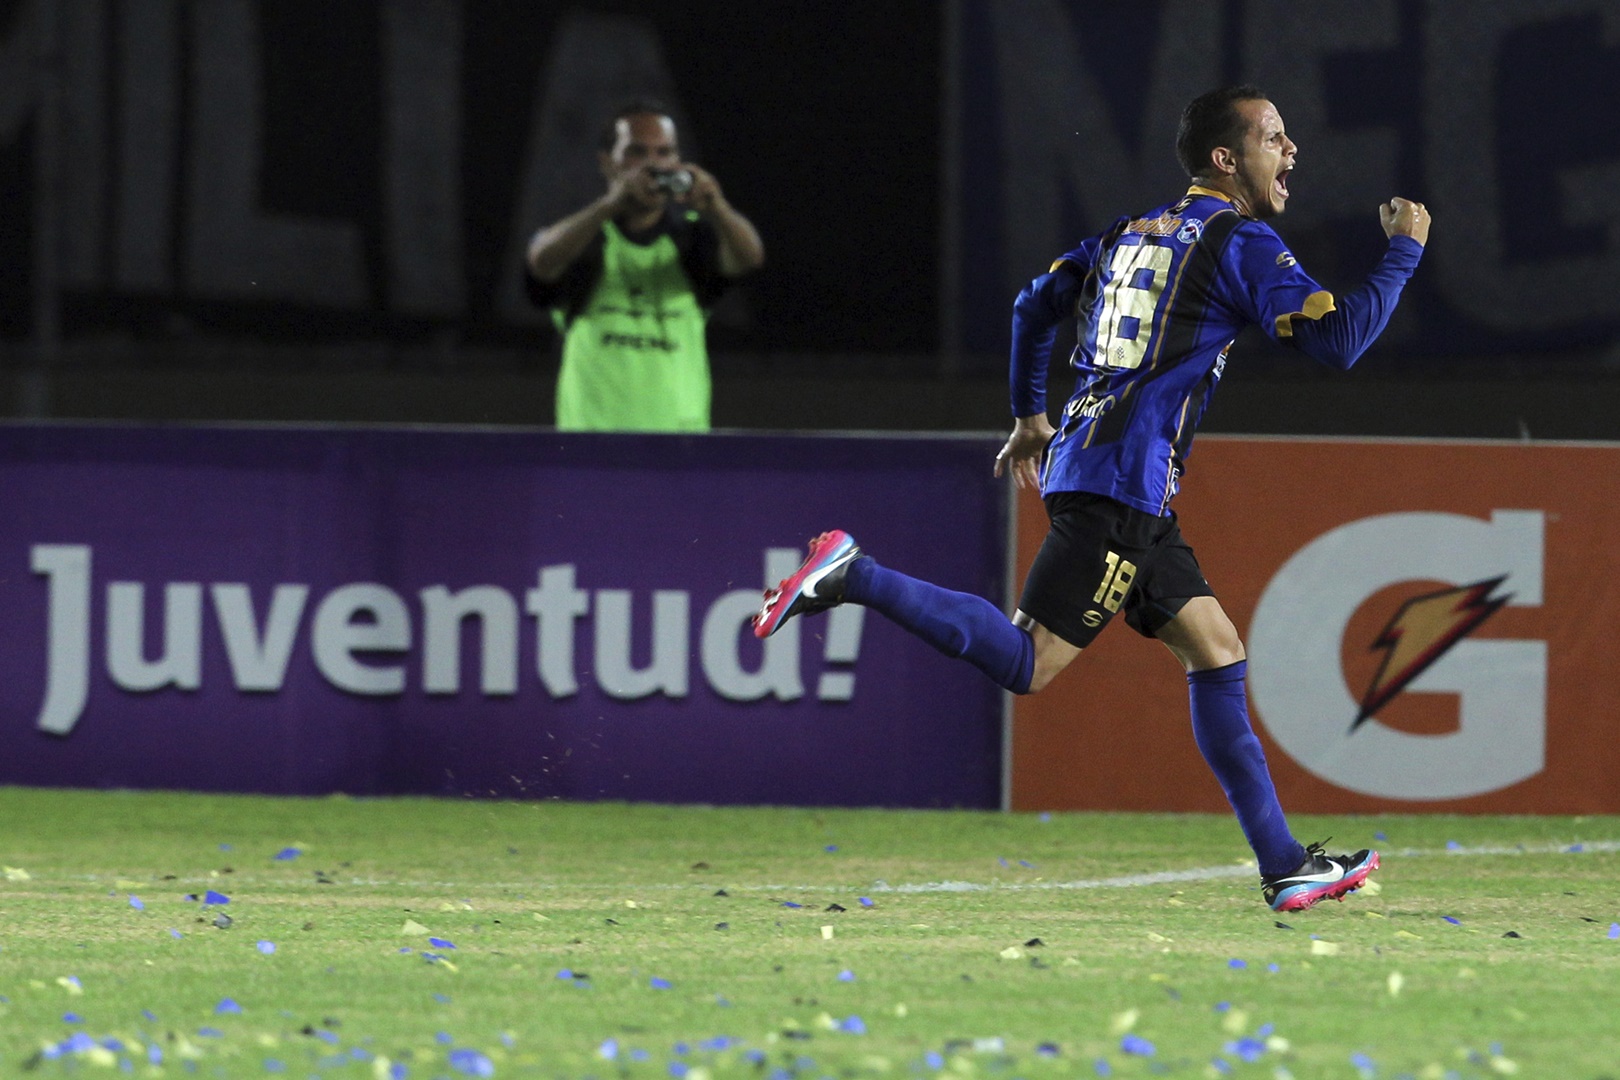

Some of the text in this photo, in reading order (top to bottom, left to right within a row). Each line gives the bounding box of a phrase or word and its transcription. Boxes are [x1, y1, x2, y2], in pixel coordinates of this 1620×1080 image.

[1092, 244, 1174, 370] 18
[30, 543, 866, 736] Juventud!
[1092, 550, 1138, 614] 18
[1247, 508, 1548, 801] G
